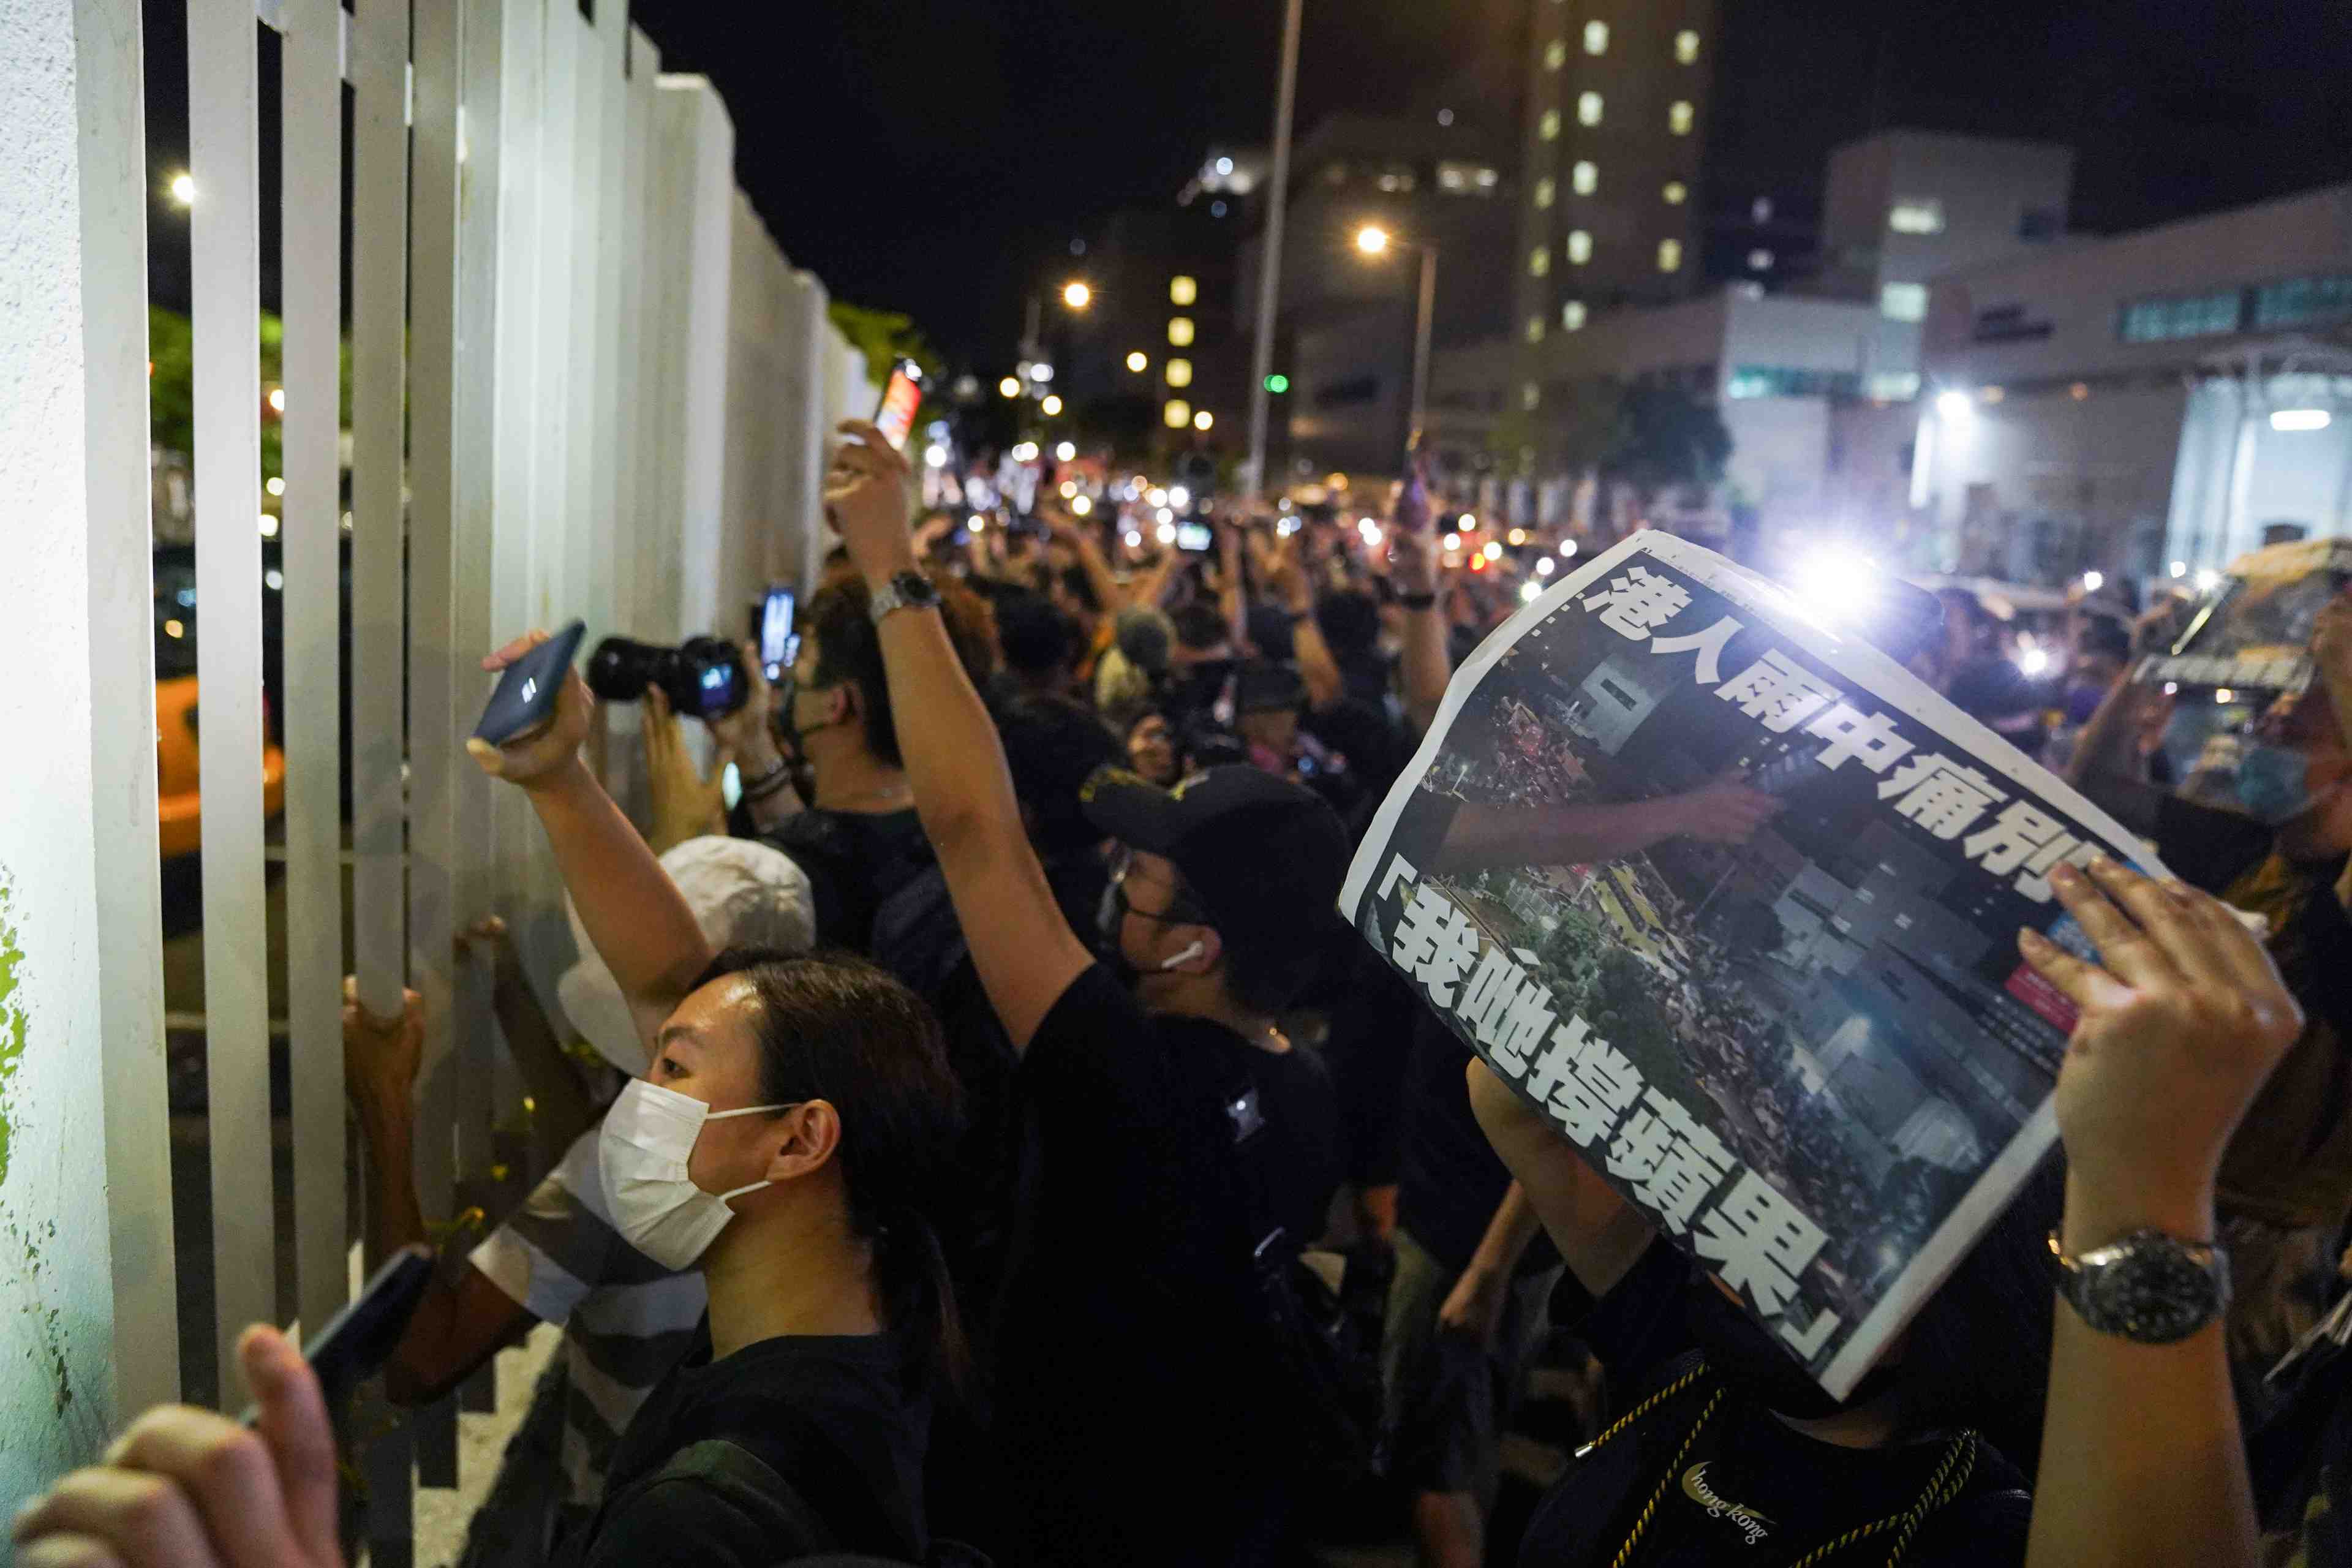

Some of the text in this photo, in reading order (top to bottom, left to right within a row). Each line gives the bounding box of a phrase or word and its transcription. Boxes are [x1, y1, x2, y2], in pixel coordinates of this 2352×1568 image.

[1582, 566, 2107, 903] 港人雨中痛別
[1691, 1468, 1768, 1545] hong kong
